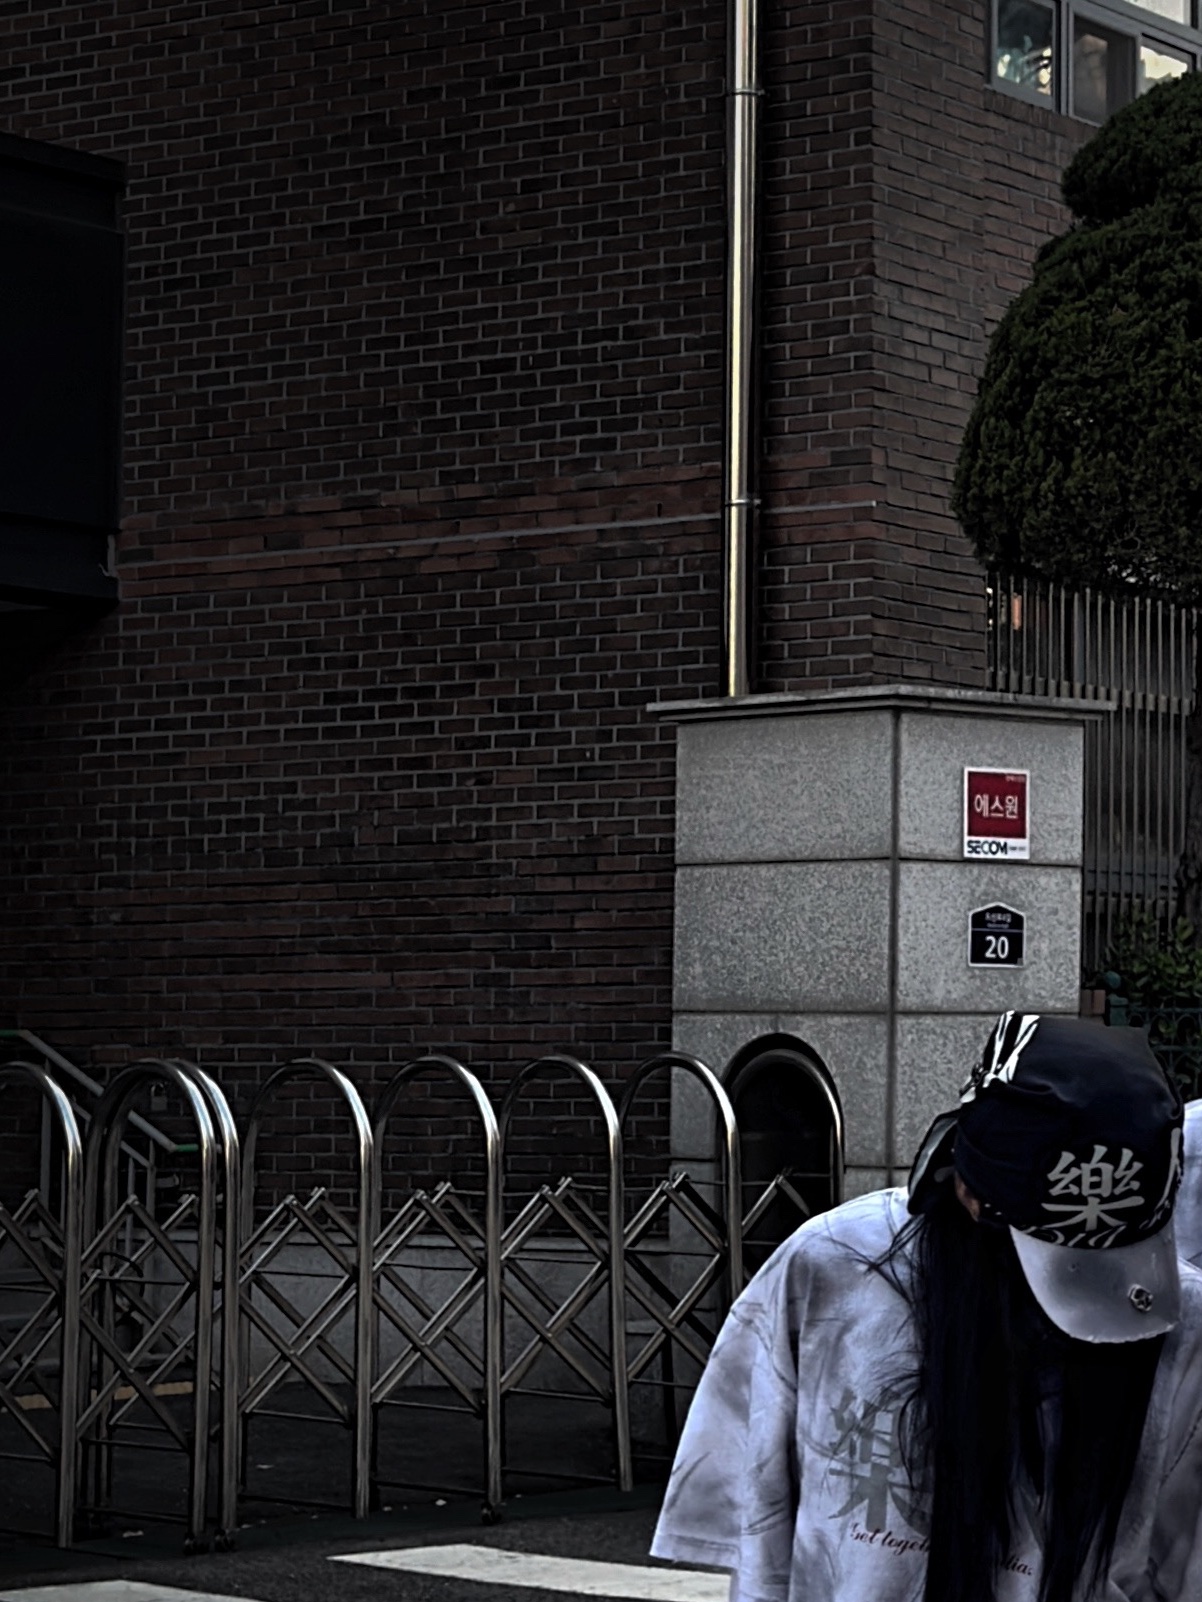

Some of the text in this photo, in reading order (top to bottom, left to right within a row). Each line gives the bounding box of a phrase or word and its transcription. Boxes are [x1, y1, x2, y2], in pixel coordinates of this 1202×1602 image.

[974, 793, 1019, 820] 에스원
[967, 840, 1008, 855] SECOM
[984, 934, 1010, 959] 20
